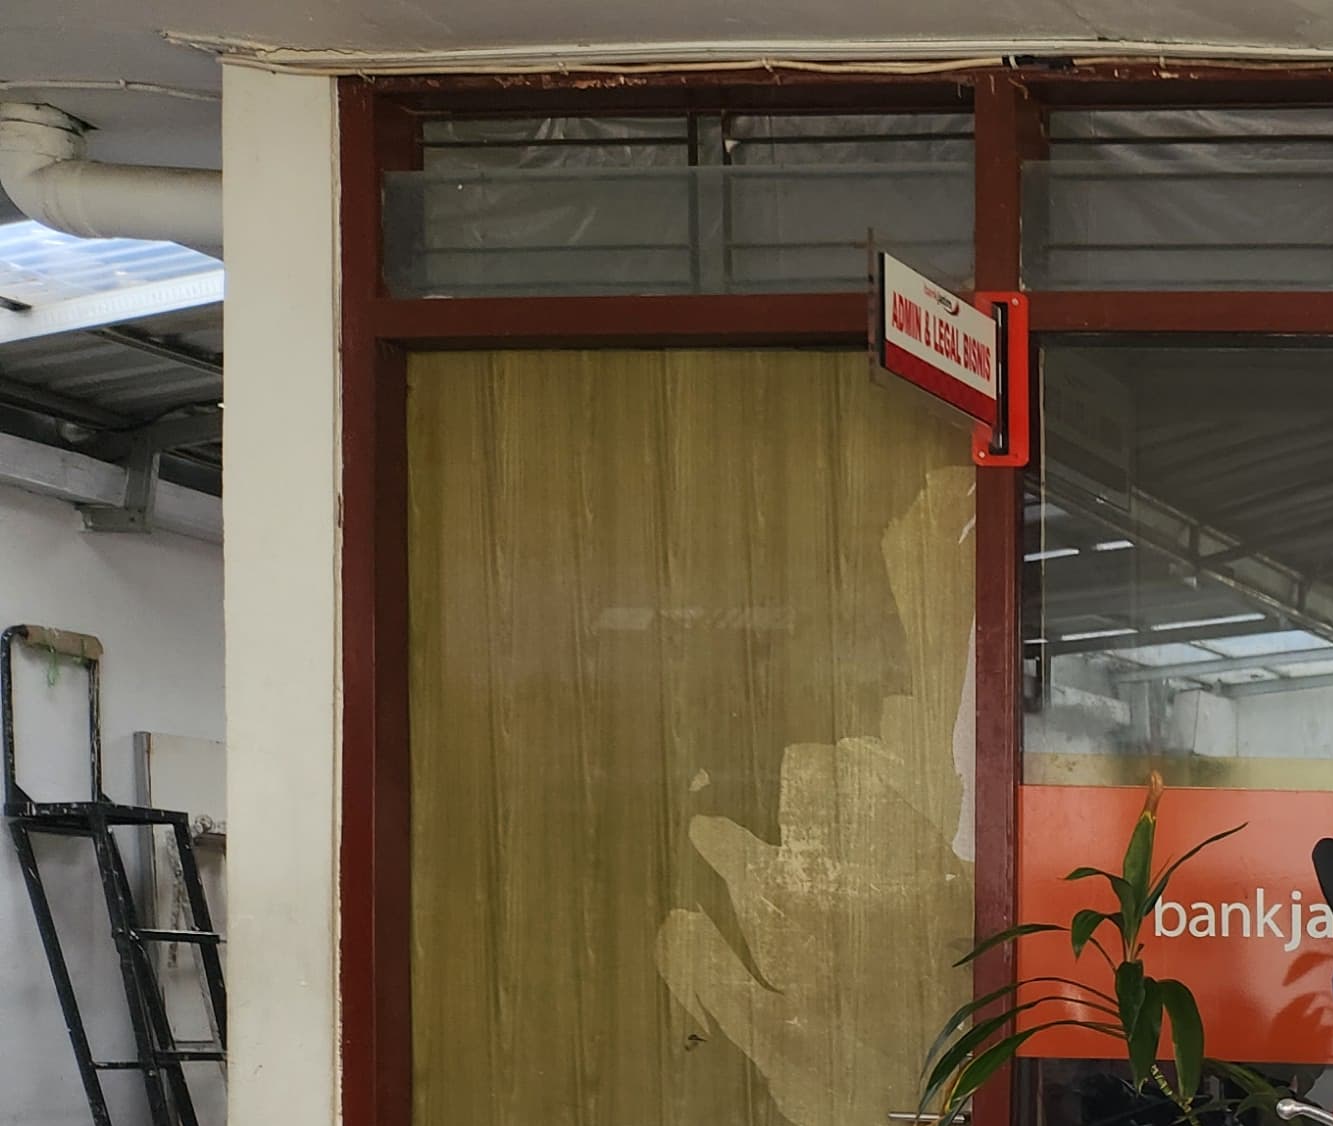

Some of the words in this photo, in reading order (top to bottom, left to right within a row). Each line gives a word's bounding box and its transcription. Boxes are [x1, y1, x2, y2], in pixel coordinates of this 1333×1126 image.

[892, 290, 922, 343] ADMIN
[924, 309, 931, 346] &
[933, 315, 962, 367] LEGAL
[963, 331, 991, 382] BISNIS
